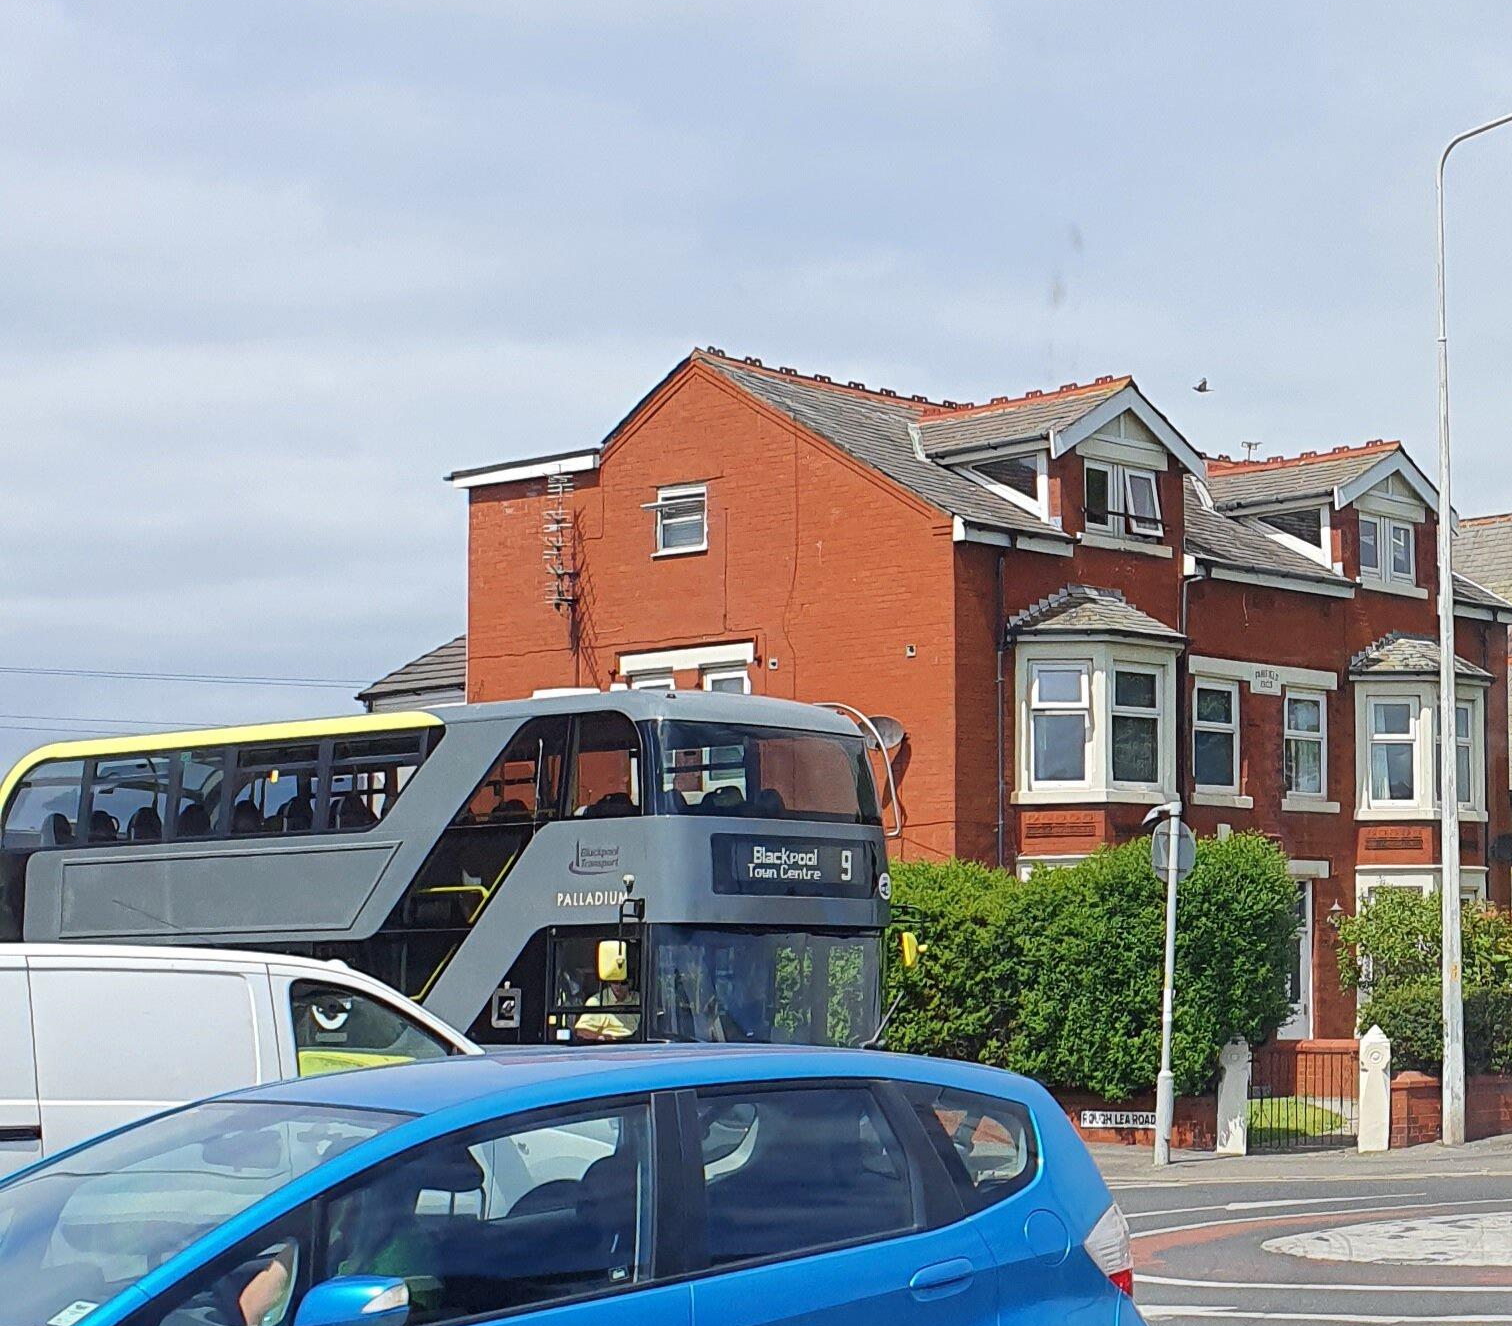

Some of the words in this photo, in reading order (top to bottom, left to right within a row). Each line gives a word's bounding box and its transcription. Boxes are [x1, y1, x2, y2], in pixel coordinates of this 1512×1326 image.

[753, 846, 818, 866] Blackpool
[747, 864, 777, 878] Town
[780, 865, 822, 880] Centre
[841, 850, 852, 881] 9
[557, 890, 629, 906] PALLADIUM
[1114, 1114, 1130, 1125] LEA
[1132, 1114, 1156, 1126] ROAD
